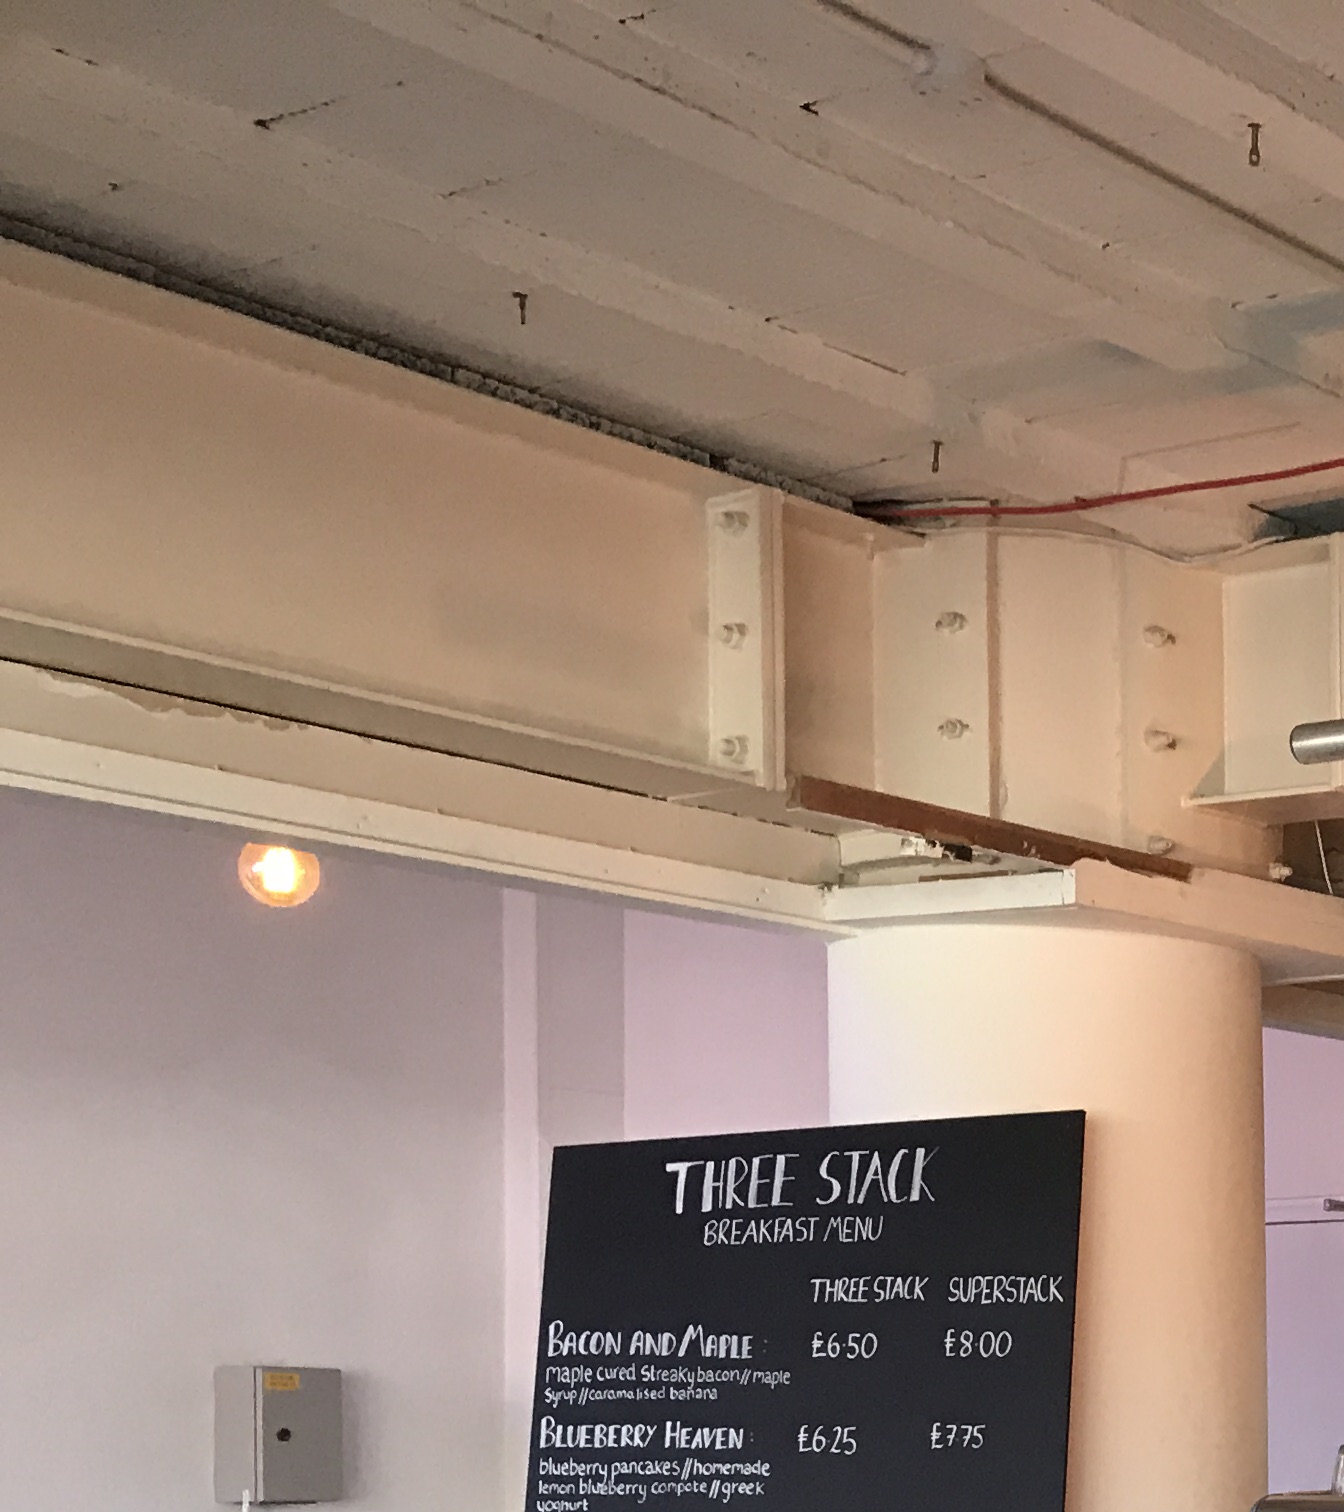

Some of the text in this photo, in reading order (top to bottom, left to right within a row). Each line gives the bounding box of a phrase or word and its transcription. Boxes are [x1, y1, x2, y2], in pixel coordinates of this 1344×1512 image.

[665, 1146, 940, 1214] THREE STACK
[703, 1215, 884, 1246] BREAKFAST MENU
[810, 1274, 1064, 1304] THREE STACK SUPERSTACK
[547, 1320, 621, 1357] BACON
[629, 1330, 677, 1356] AND
[545, 1365, 592, 1388] maple
[597, 1363, 636, 1382] cured
[670, 1386, 718, 1401] banana
[539, 1415, 657, 1449] BLUEBERRY
[539, 1457, 607, 1482] blueberry
[538, 1480, 575, 1495] lemon
[579, 1479, 647, 1503] blueberry
